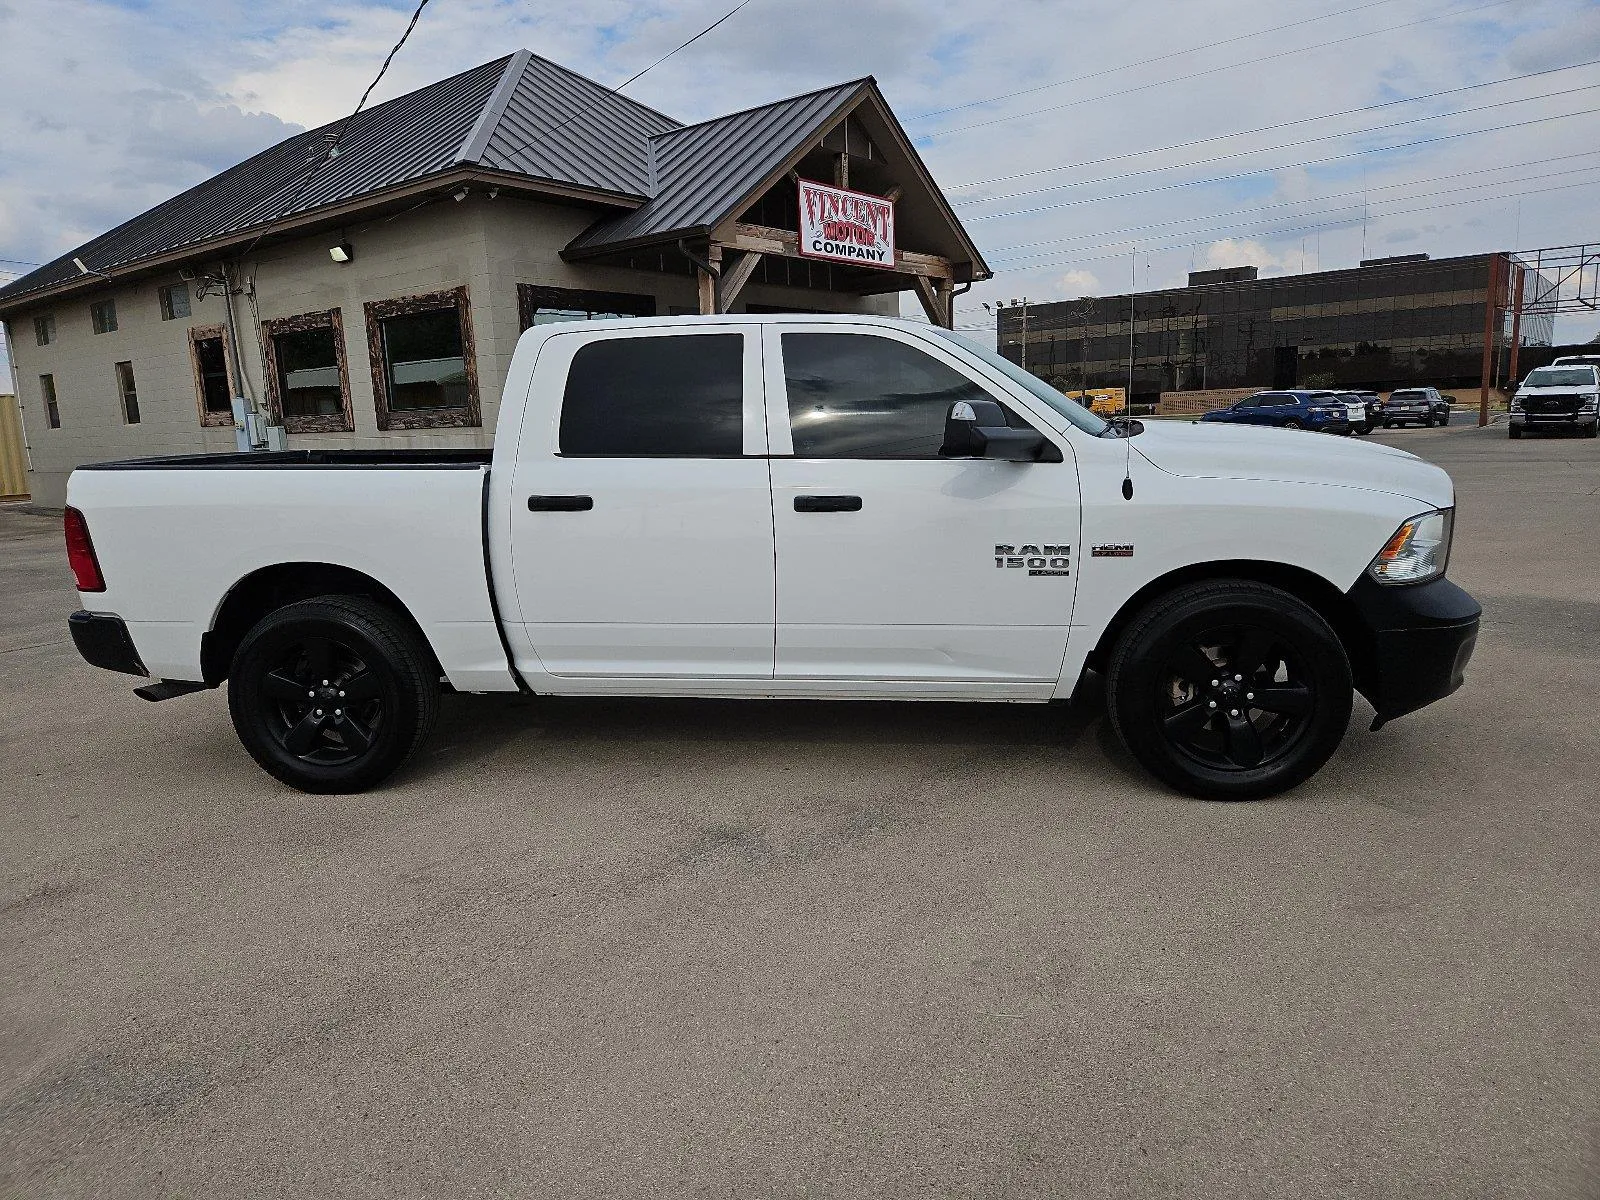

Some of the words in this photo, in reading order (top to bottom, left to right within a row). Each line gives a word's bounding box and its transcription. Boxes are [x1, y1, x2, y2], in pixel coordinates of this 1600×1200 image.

[803, 186, 890, 247] VINCENT
[823, 220, 876, 248] MOTOR
[812, 240, 886, 261] COMPANY
[995, 543, 1070, 555] RAM
[995, 557, 1069, 568] 1500
